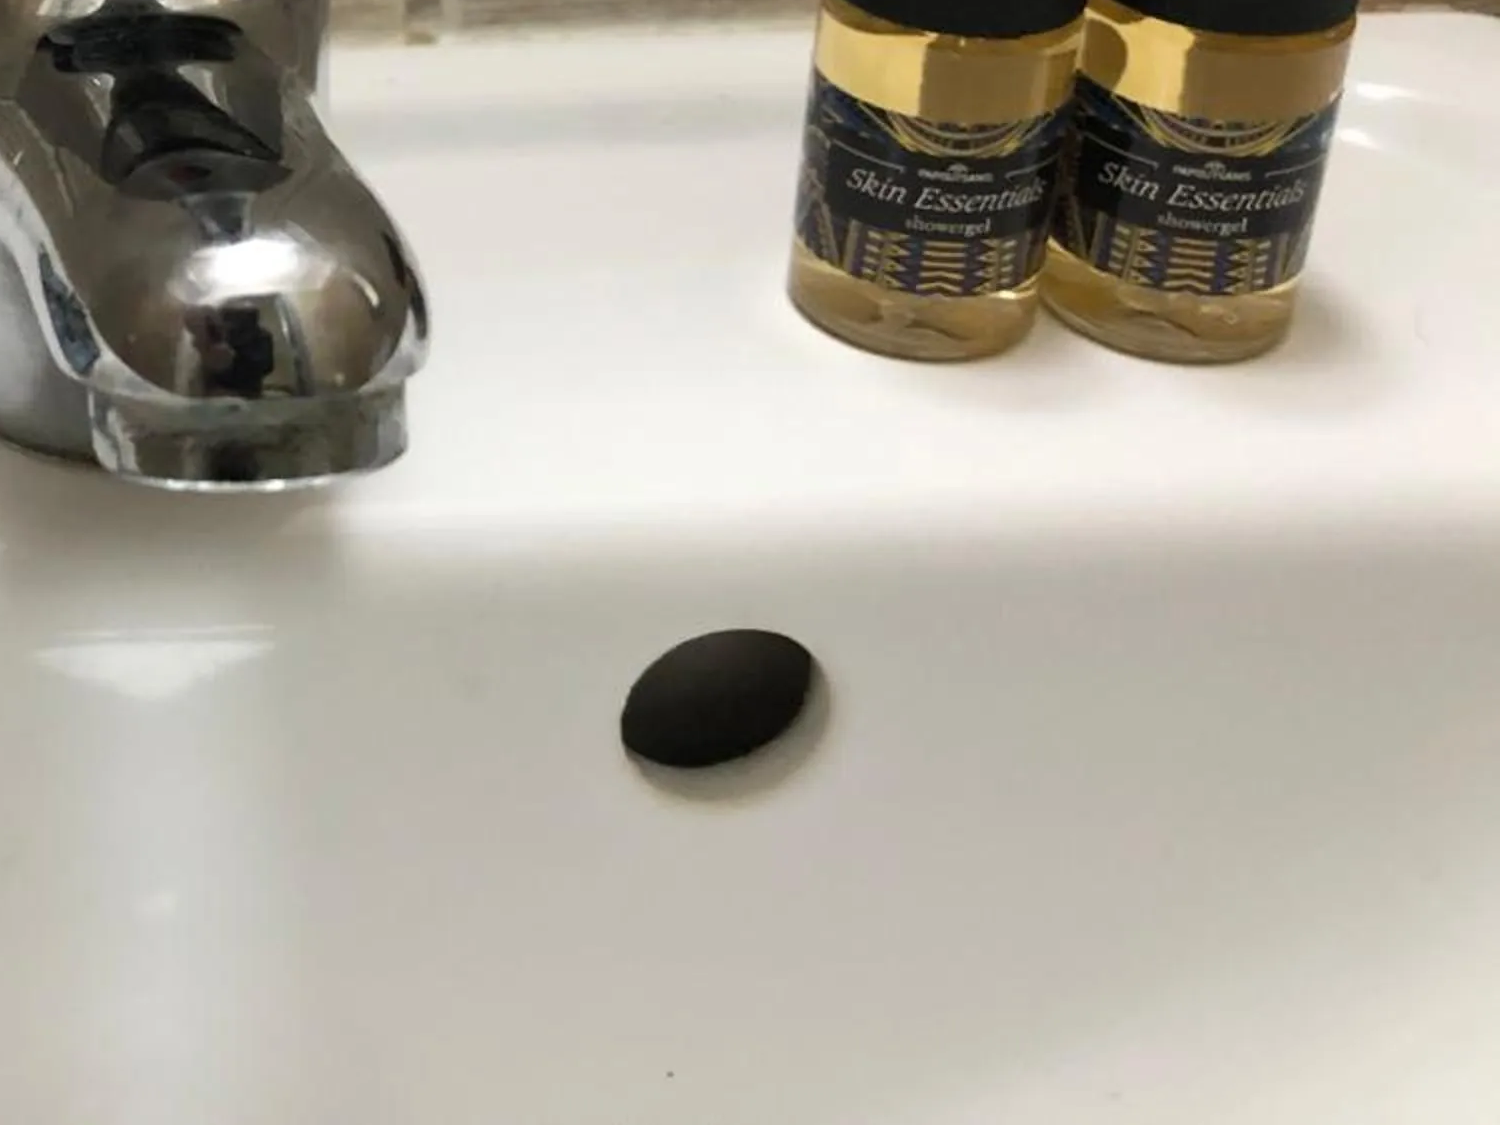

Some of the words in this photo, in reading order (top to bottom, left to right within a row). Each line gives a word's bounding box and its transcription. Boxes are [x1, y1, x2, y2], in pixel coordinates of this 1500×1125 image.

[845, 168, 908, 205] Skin
[913, 179, 1046, 214] Essentials
[1097, 160, 1161, 201] Skin
[1166, 178, 1308, 212] Essentials
[904, 215, 992, 239] showergel
[1156, 211, 1249, 238] showergel
